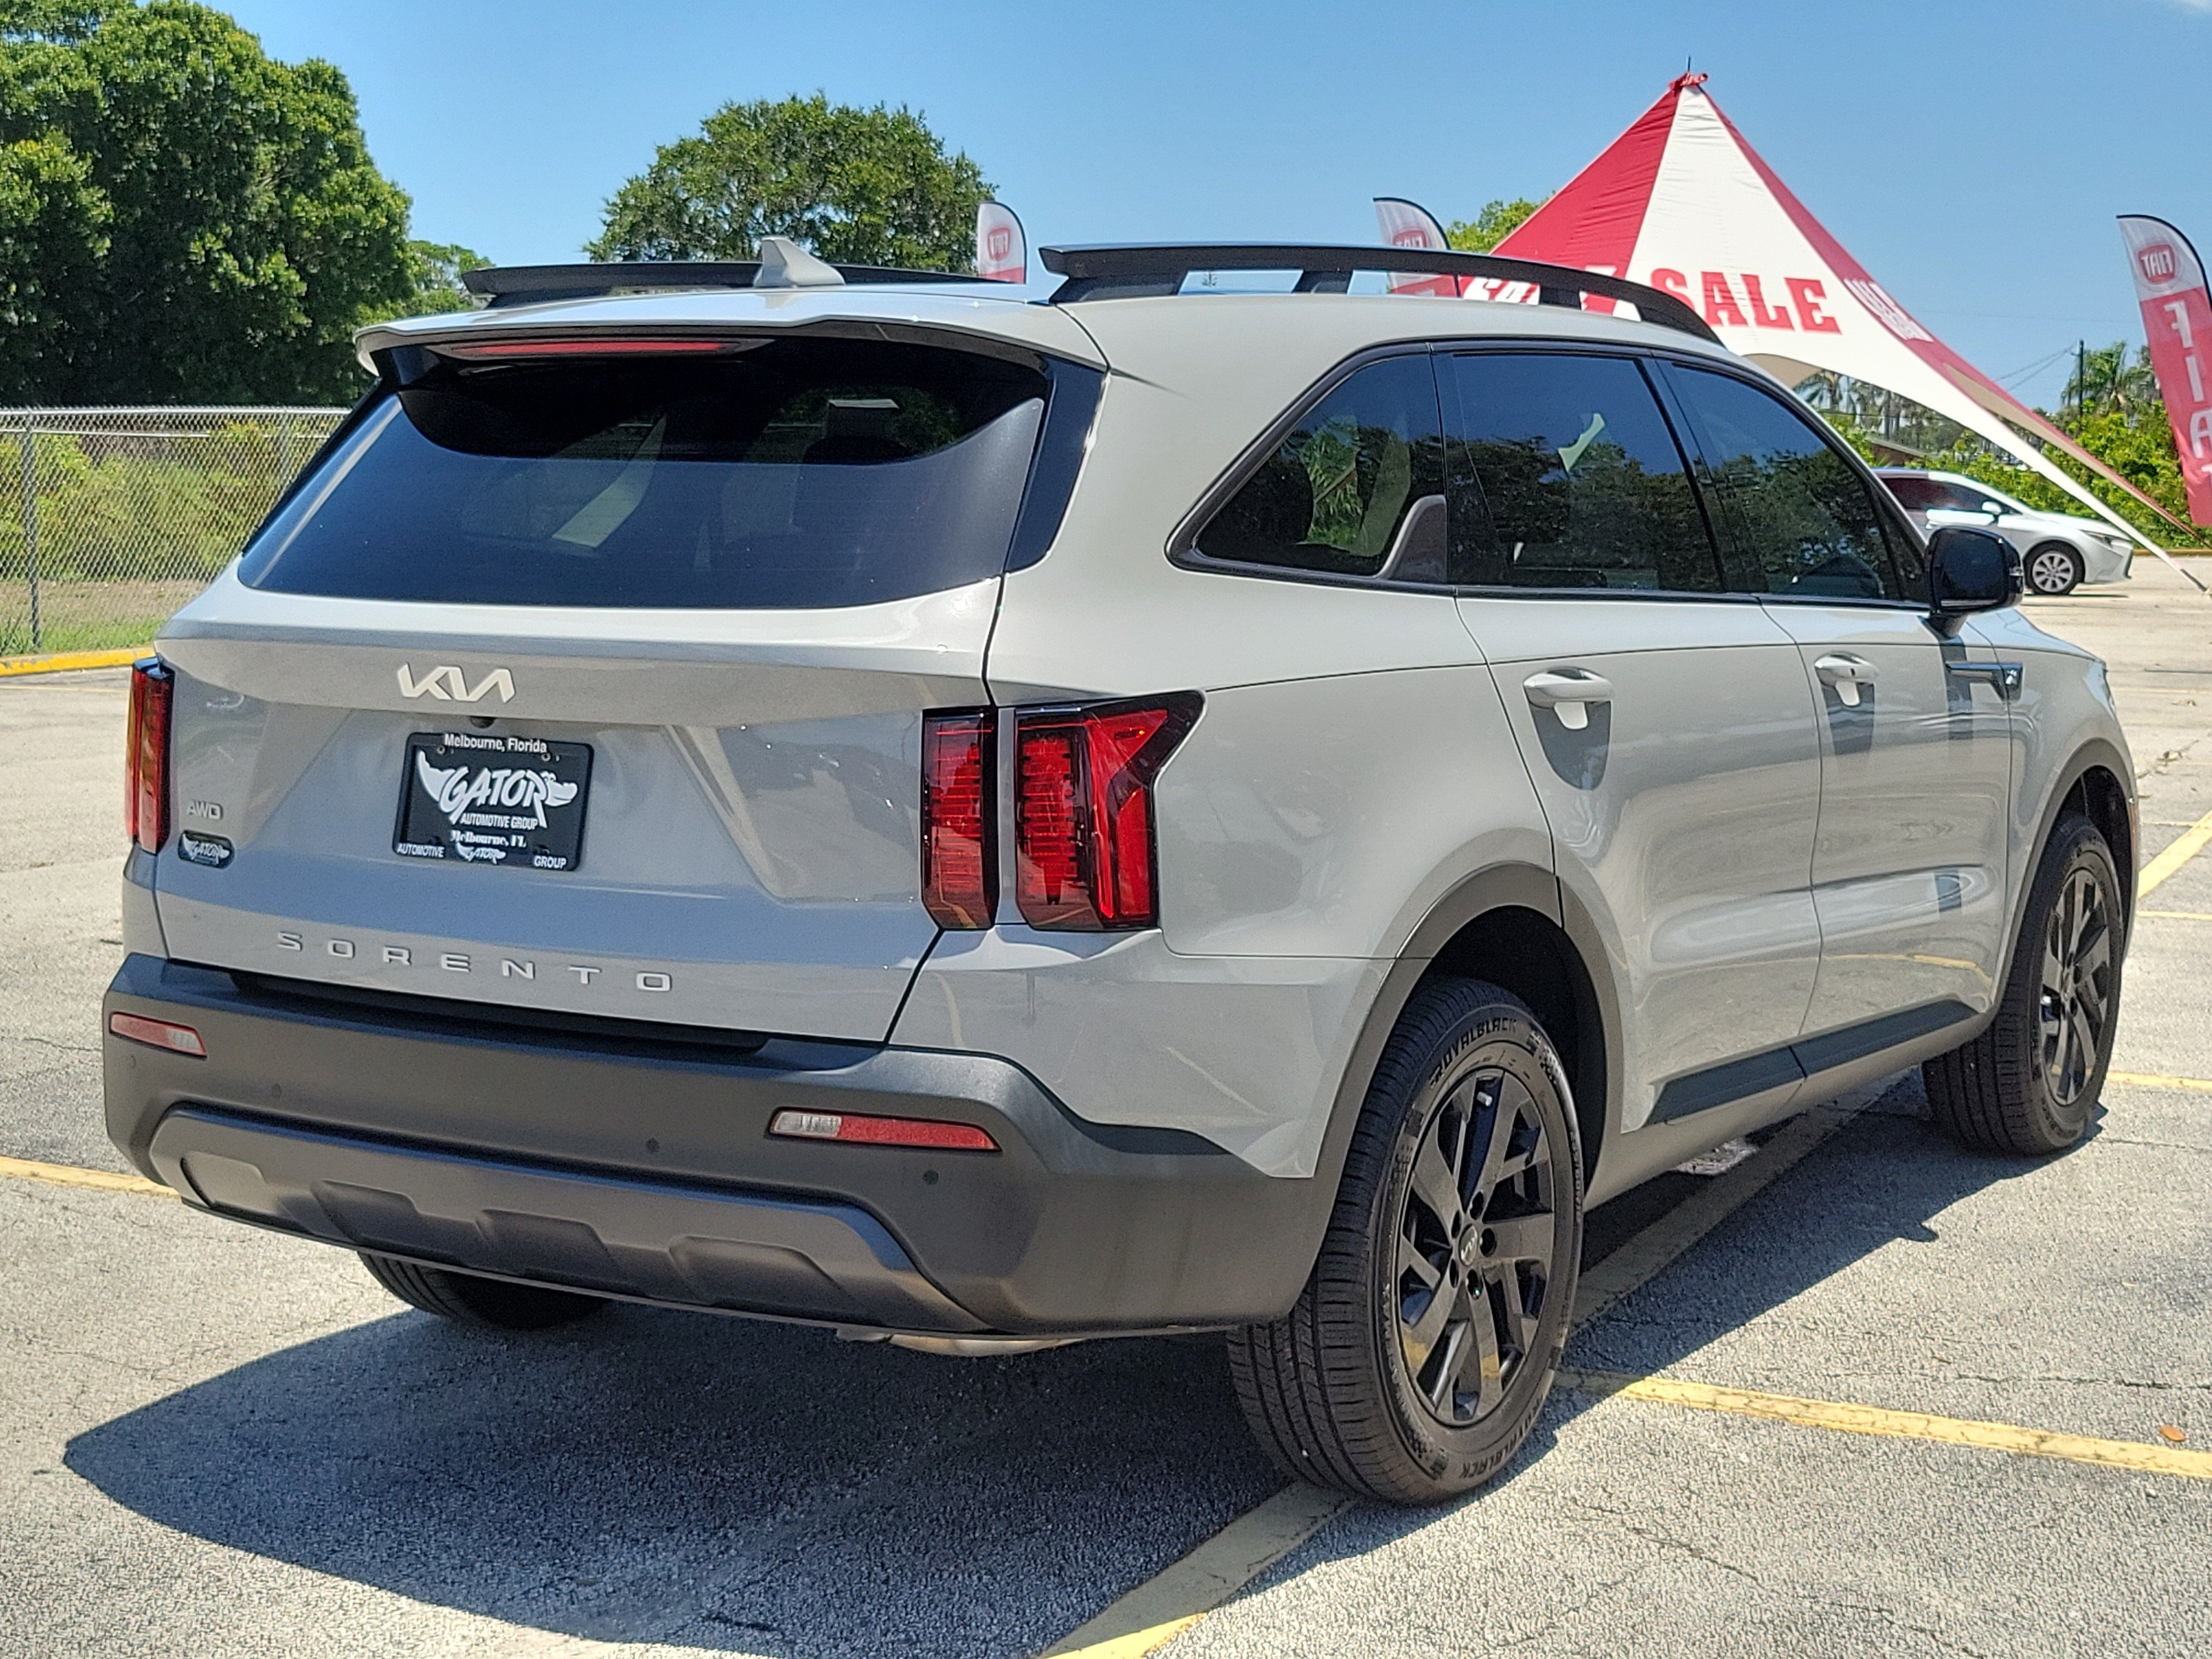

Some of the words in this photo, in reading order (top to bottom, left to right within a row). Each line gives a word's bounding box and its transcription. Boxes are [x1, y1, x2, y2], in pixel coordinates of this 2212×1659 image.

[1650, 268, 1842, 336] SALE
[397, 662, 516, 703] KIA
[444, 733, 506, 752] Melbourne,
[508, 737, 548, 754] Florida
[187, 800, 223, 820] AWD
[439, 767, 548, 829] GATOR
[459, 812, 510, 828] AUTOMOTIVE
[510, 817, 539, 831] GROUP
[397, 843, 444, 858] AUTOMOTIVE
[534, 855, 567, 869] GROUP
[277, 930, 673, 992] SORENTO
